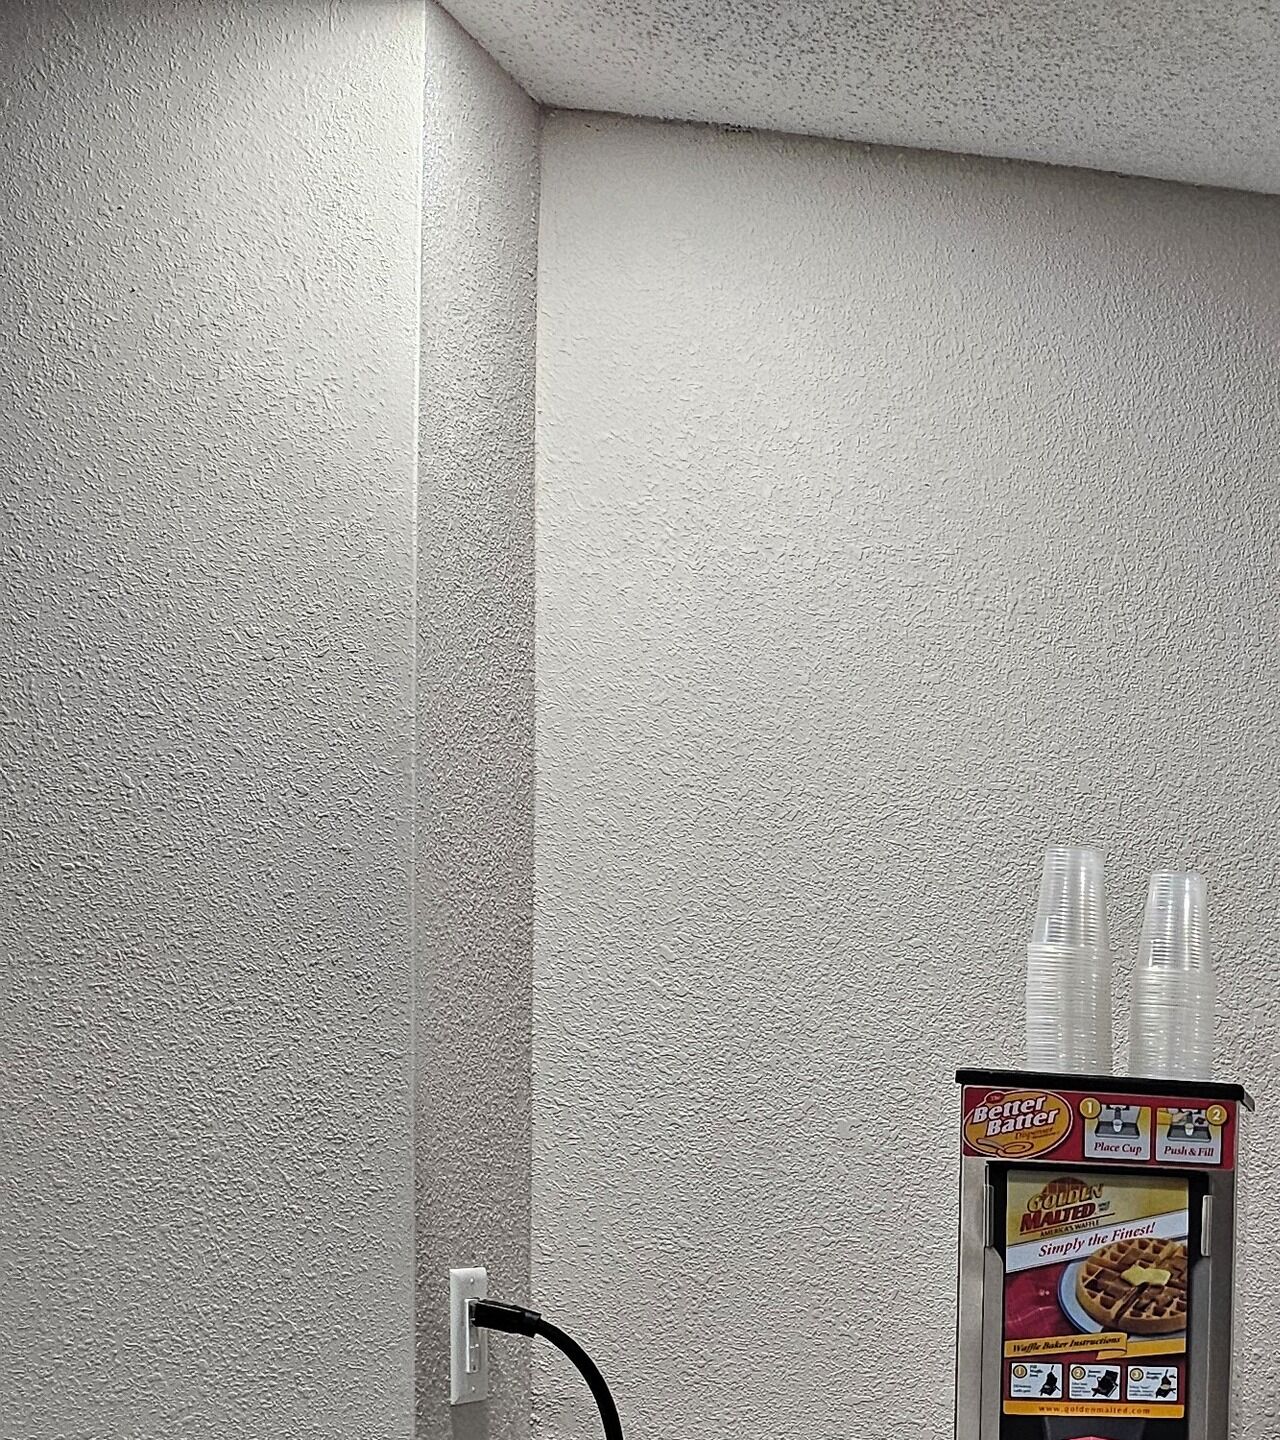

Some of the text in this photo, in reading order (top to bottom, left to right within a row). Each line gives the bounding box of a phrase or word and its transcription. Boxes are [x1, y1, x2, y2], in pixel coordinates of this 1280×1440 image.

[972, 1096, 1047, 1124] Better
[1088, 1102, 1092, 1114] 1
[1212, 1110, 1220, 1120] 2
[986, 1109, 1059, 1136] Batter
[1093, 1142, 1142, 1155] Place Cup
[1164, 1145, 1214, 1157] Push & Fill
[1027, 1183, 1104, 1213] GOLDEN
[1020, 1202, 1095, 1232] MALTED
[1039, 1222, 1155, 1256] Simply the Finest!
[1013, 1337, 1120, 1353] Waffle Baker Instructions
